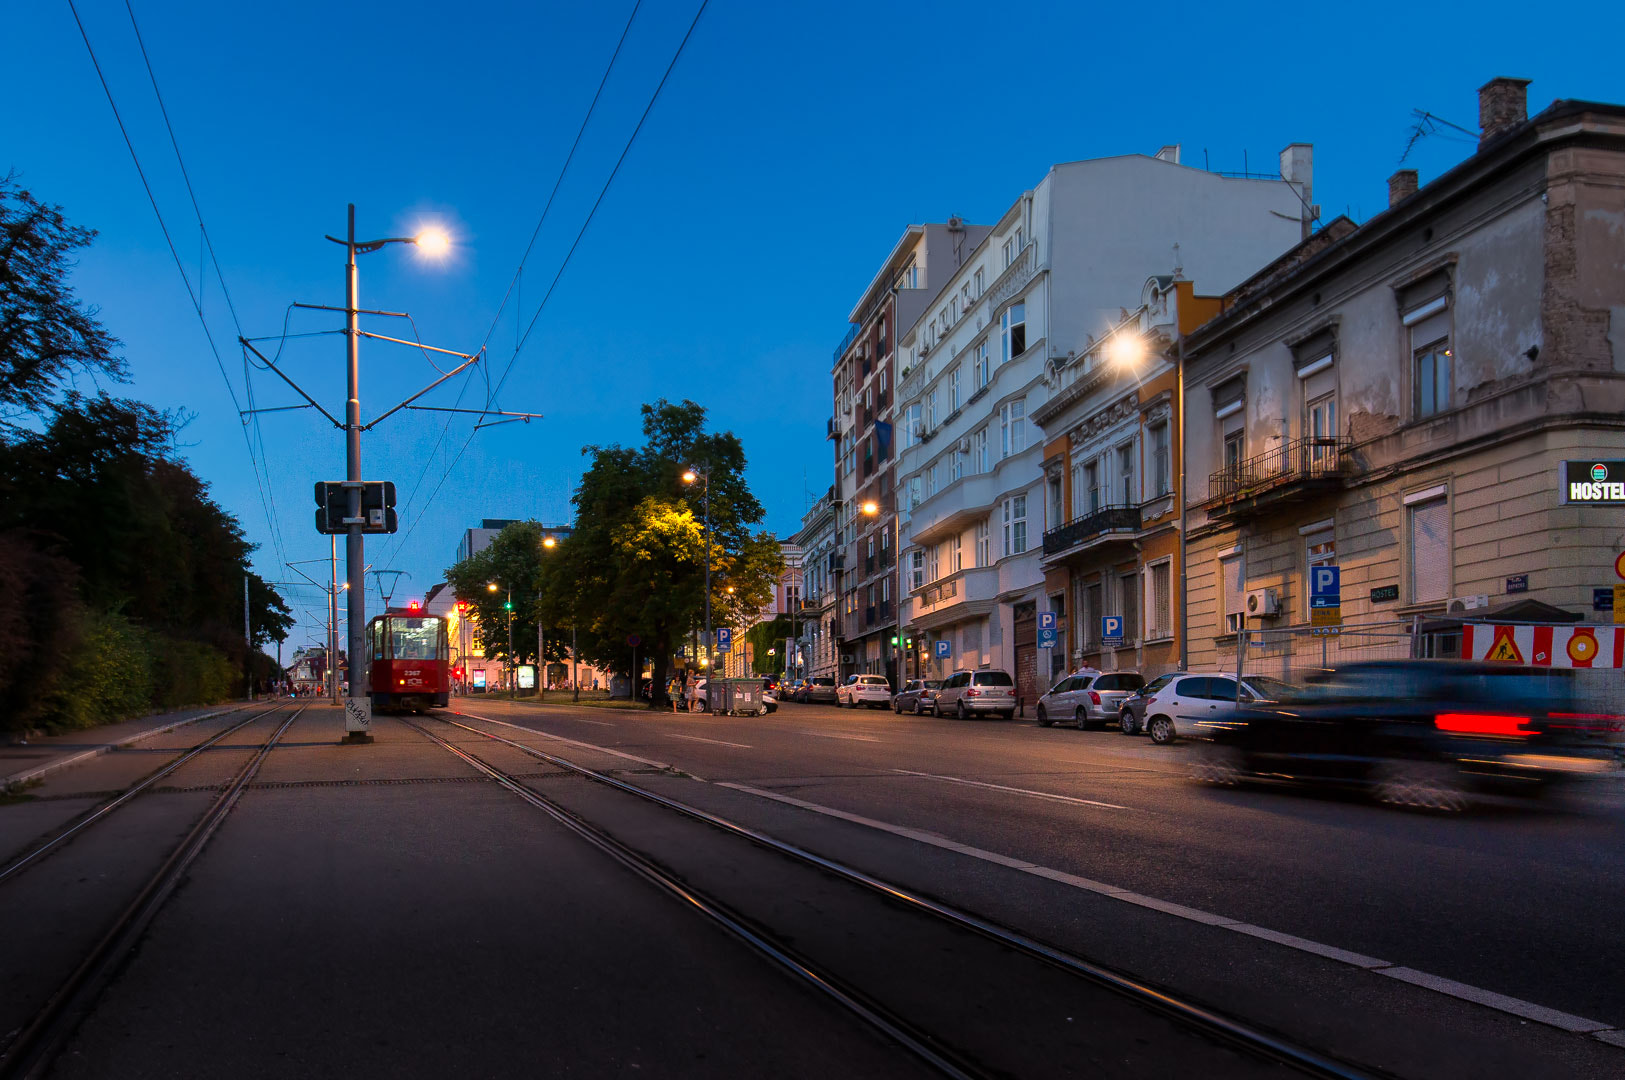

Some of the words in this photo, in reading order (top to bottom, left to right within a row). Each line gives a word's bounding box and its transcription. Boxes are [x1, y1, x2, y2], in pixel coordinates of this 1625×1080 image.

[1570, 482, 1625, 500] HOSTEL
[1318, 570, 1333, 592] P
[1372, 588, 1395, 599] HOSTEL
[1043, 615, 1052, 627] P
[1107, 619, 1118, 634] P
[720, 630, 728, 641] P
[939, 643, 947, 654] P
